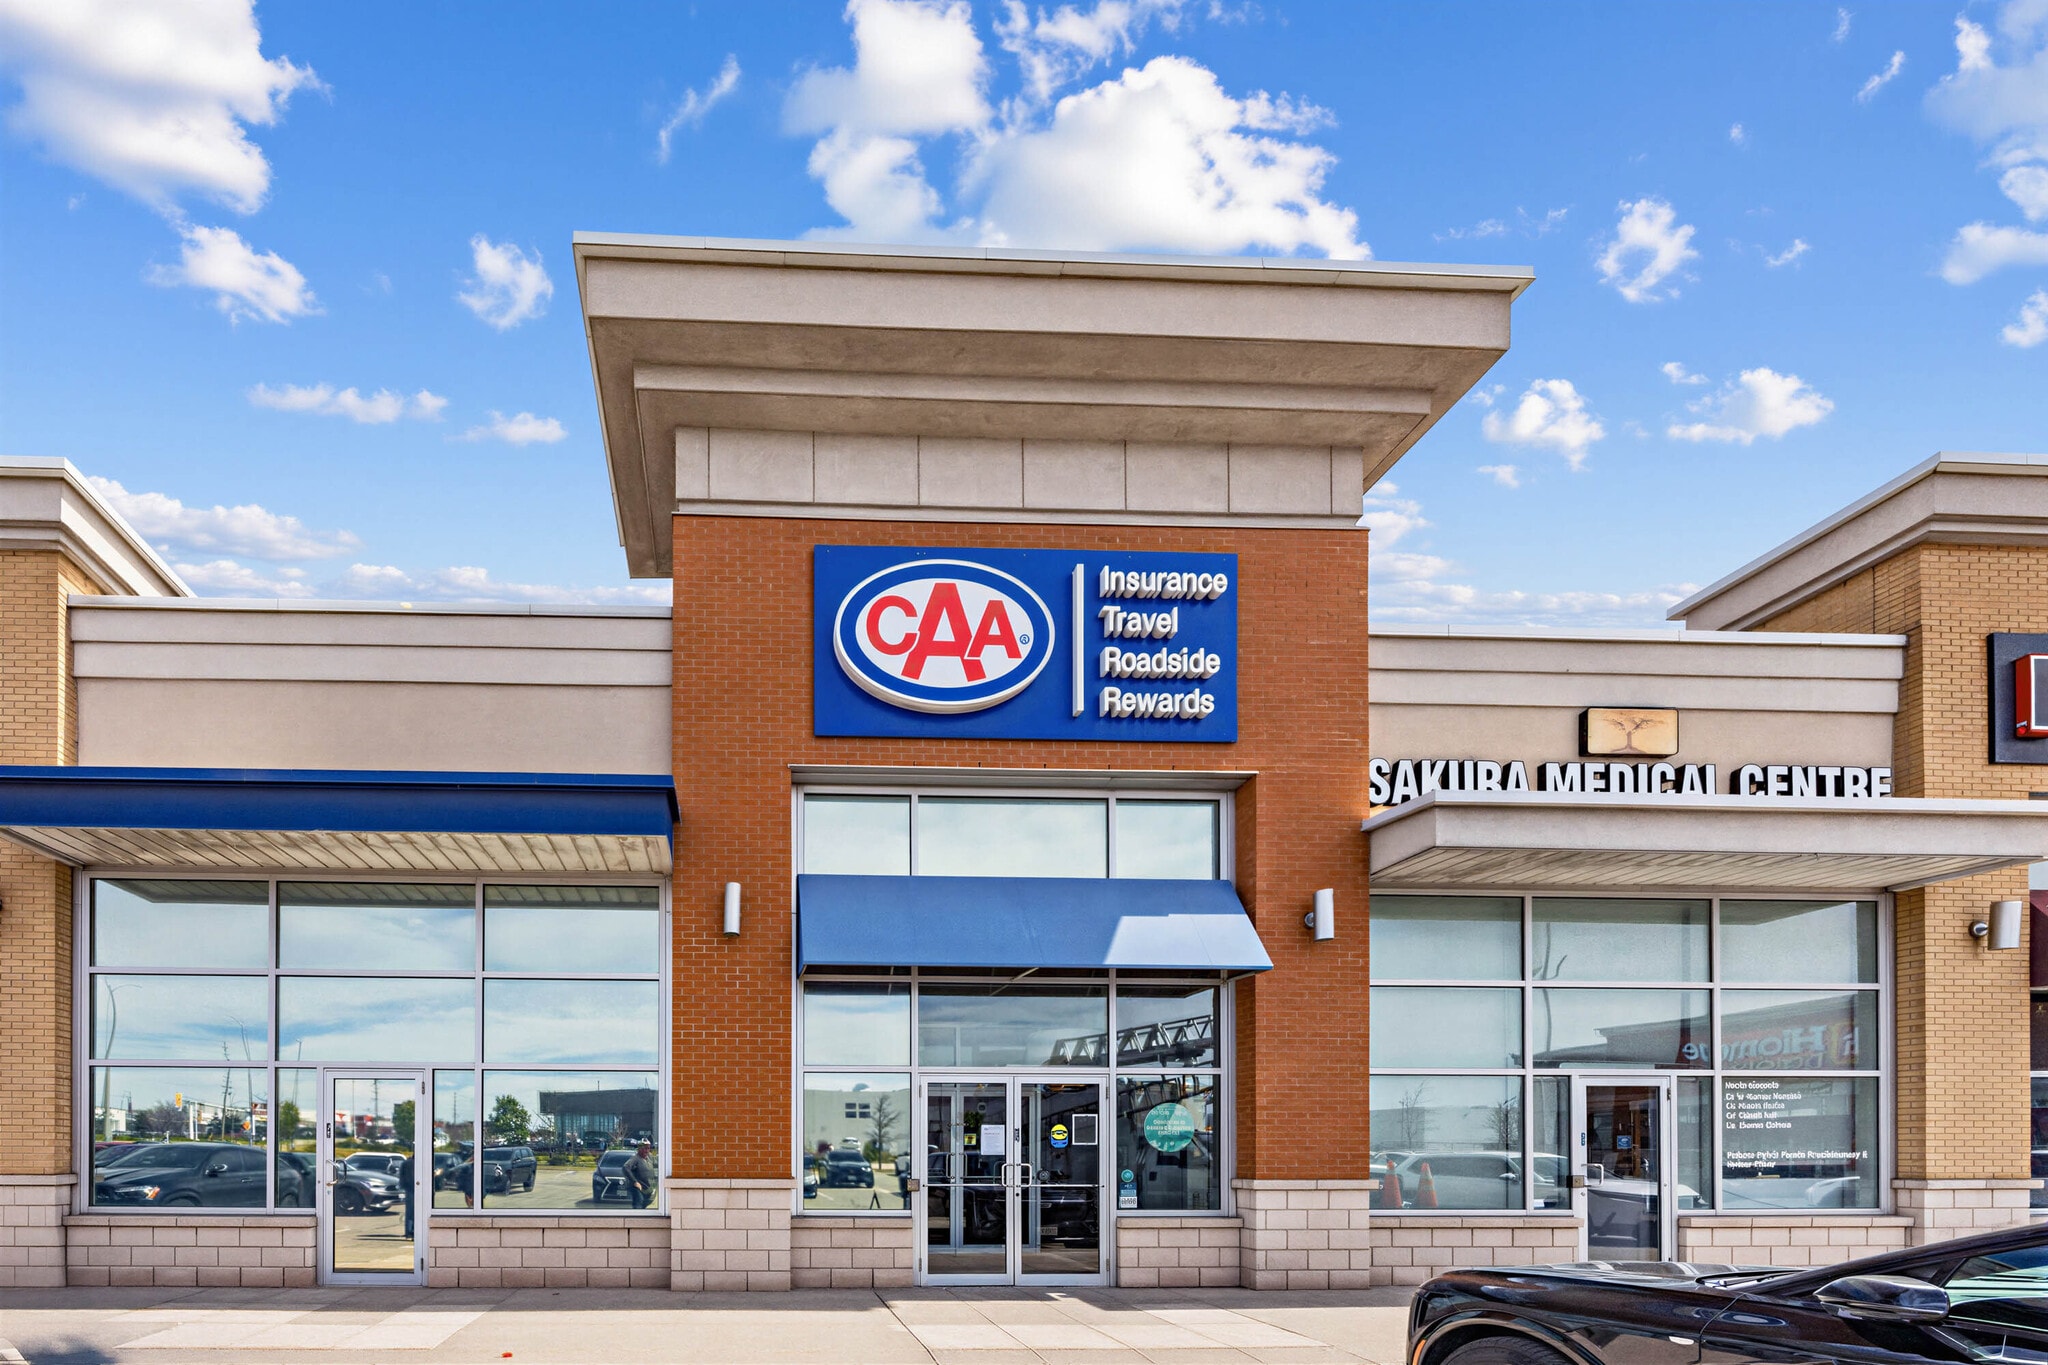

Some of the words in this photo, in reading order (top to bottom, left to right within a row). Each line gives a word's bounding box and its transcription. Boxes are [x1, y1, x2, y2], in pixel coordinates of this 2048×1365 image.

[1099, 565, 1228, 600] Insurance
[865, 582, 1023, 683] CAA
[1098, 605, 1179, 639] Travel
[1099, 646, 1221, 679] Roadside
[1099, 686, 1215, 719] Rewards
[1368, 757, 1531, 805] SAKURA
[1737, 763, 1893, 798] CENTRE
